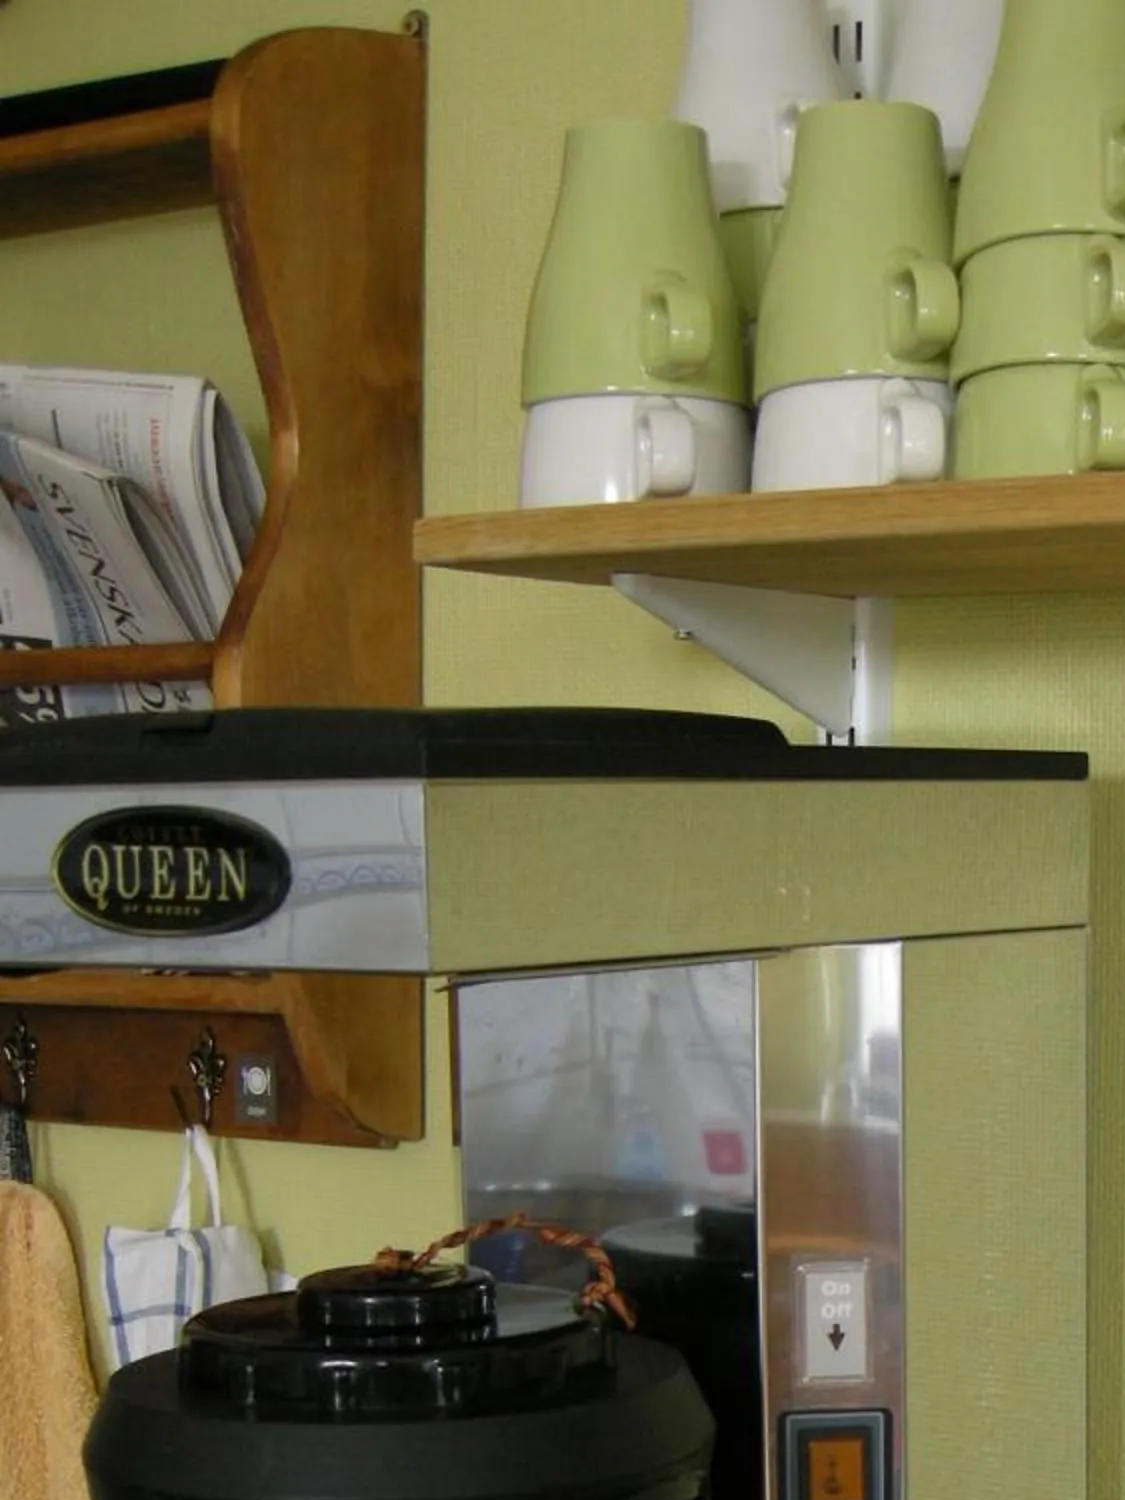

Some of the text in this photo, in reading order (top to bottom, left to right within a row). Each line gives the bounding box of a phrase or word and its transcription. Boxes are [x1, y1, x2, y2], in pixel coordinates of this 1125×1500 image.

[82, 844, 246, 910] QUEEN
[821, 1280, 852, 1296] On
[821, 1302, 853, 1319] Off
